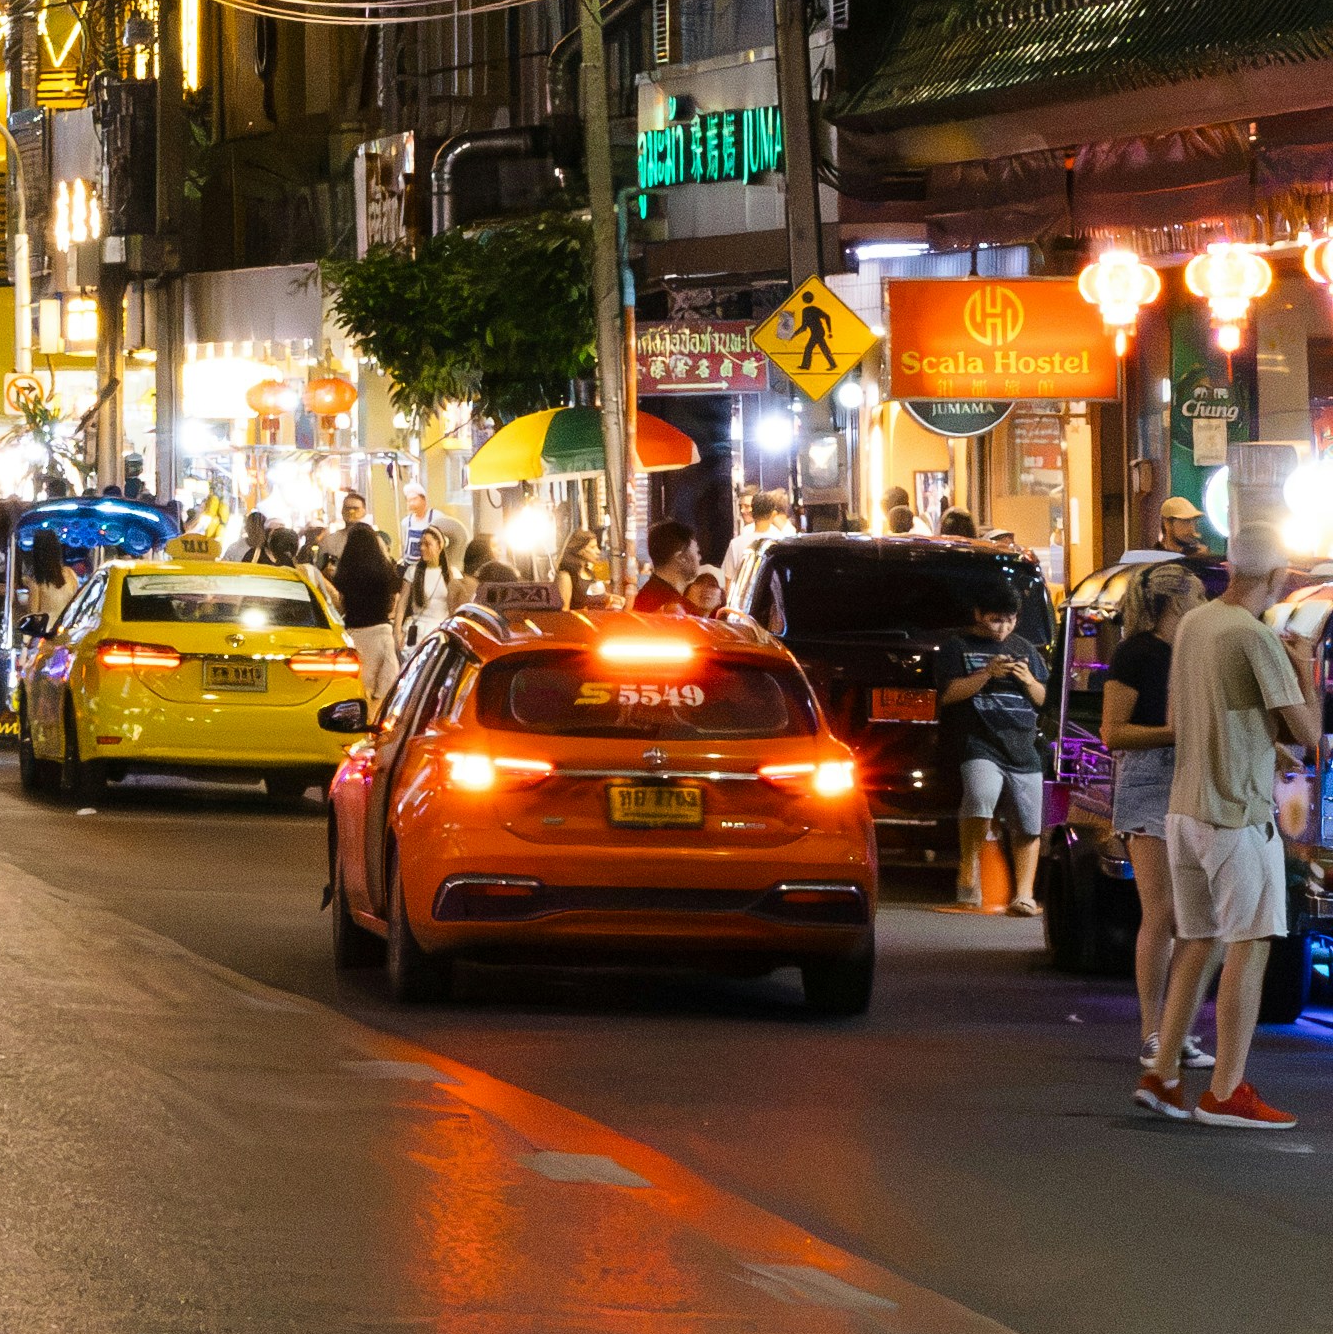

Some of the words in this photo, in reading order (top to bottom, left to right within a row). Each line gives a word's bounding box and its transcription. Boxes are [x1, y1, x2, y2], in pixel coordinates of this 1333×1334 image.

[901, 351, 985, 375] Scala
[994, 350, 1090, 375] Hostel
[932, 402, 995, 416] JUMAMA
[618, 683, 705, 708] 5549
